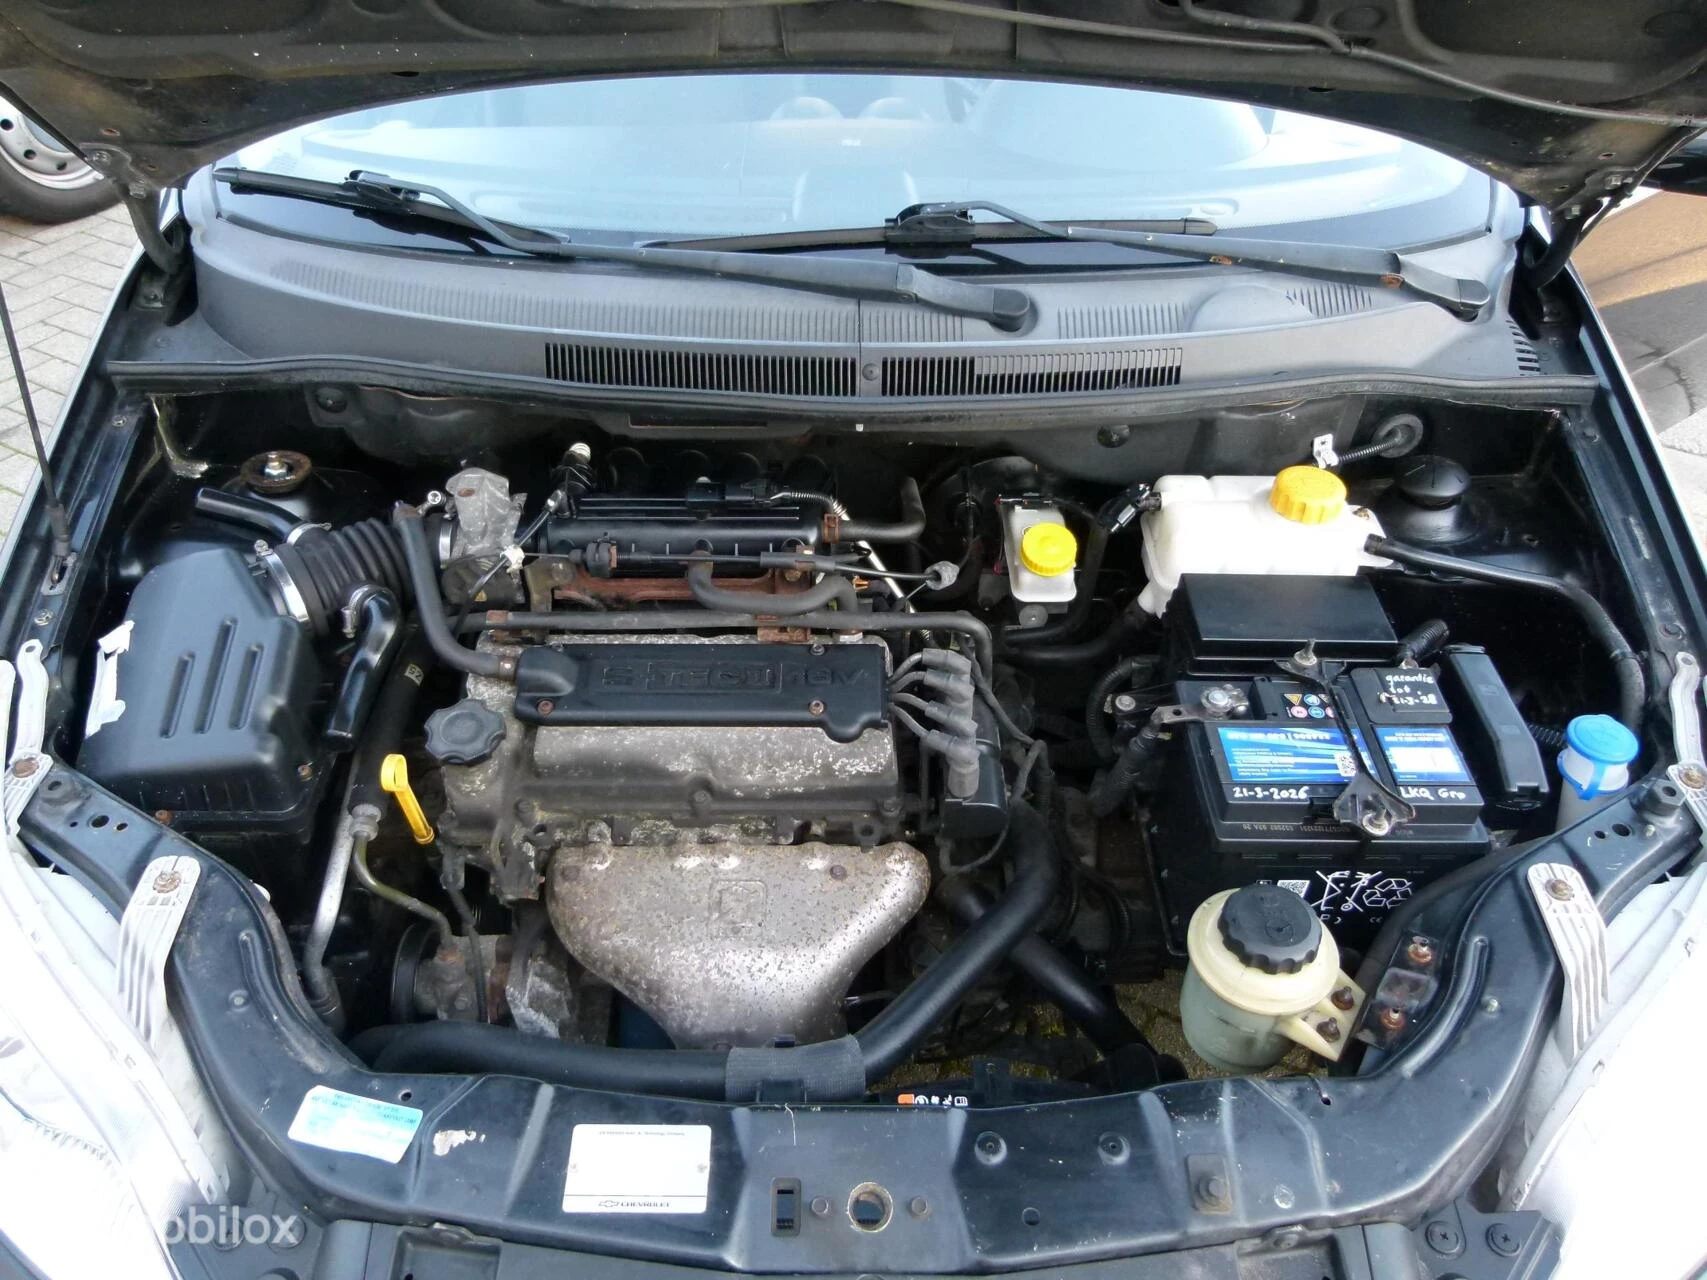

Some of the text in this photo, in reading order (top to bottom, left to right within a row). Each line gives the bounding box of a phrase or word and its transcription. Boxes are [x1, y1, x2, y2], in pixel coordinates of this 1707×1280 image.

[1385, 673, 1435, 687] garantie
[1232, 786, 1310, 800] 21-3-2026
[1399, 786, 1435, 801] LKQ
[620, 1200, 671, 1209] CHEVROLET
